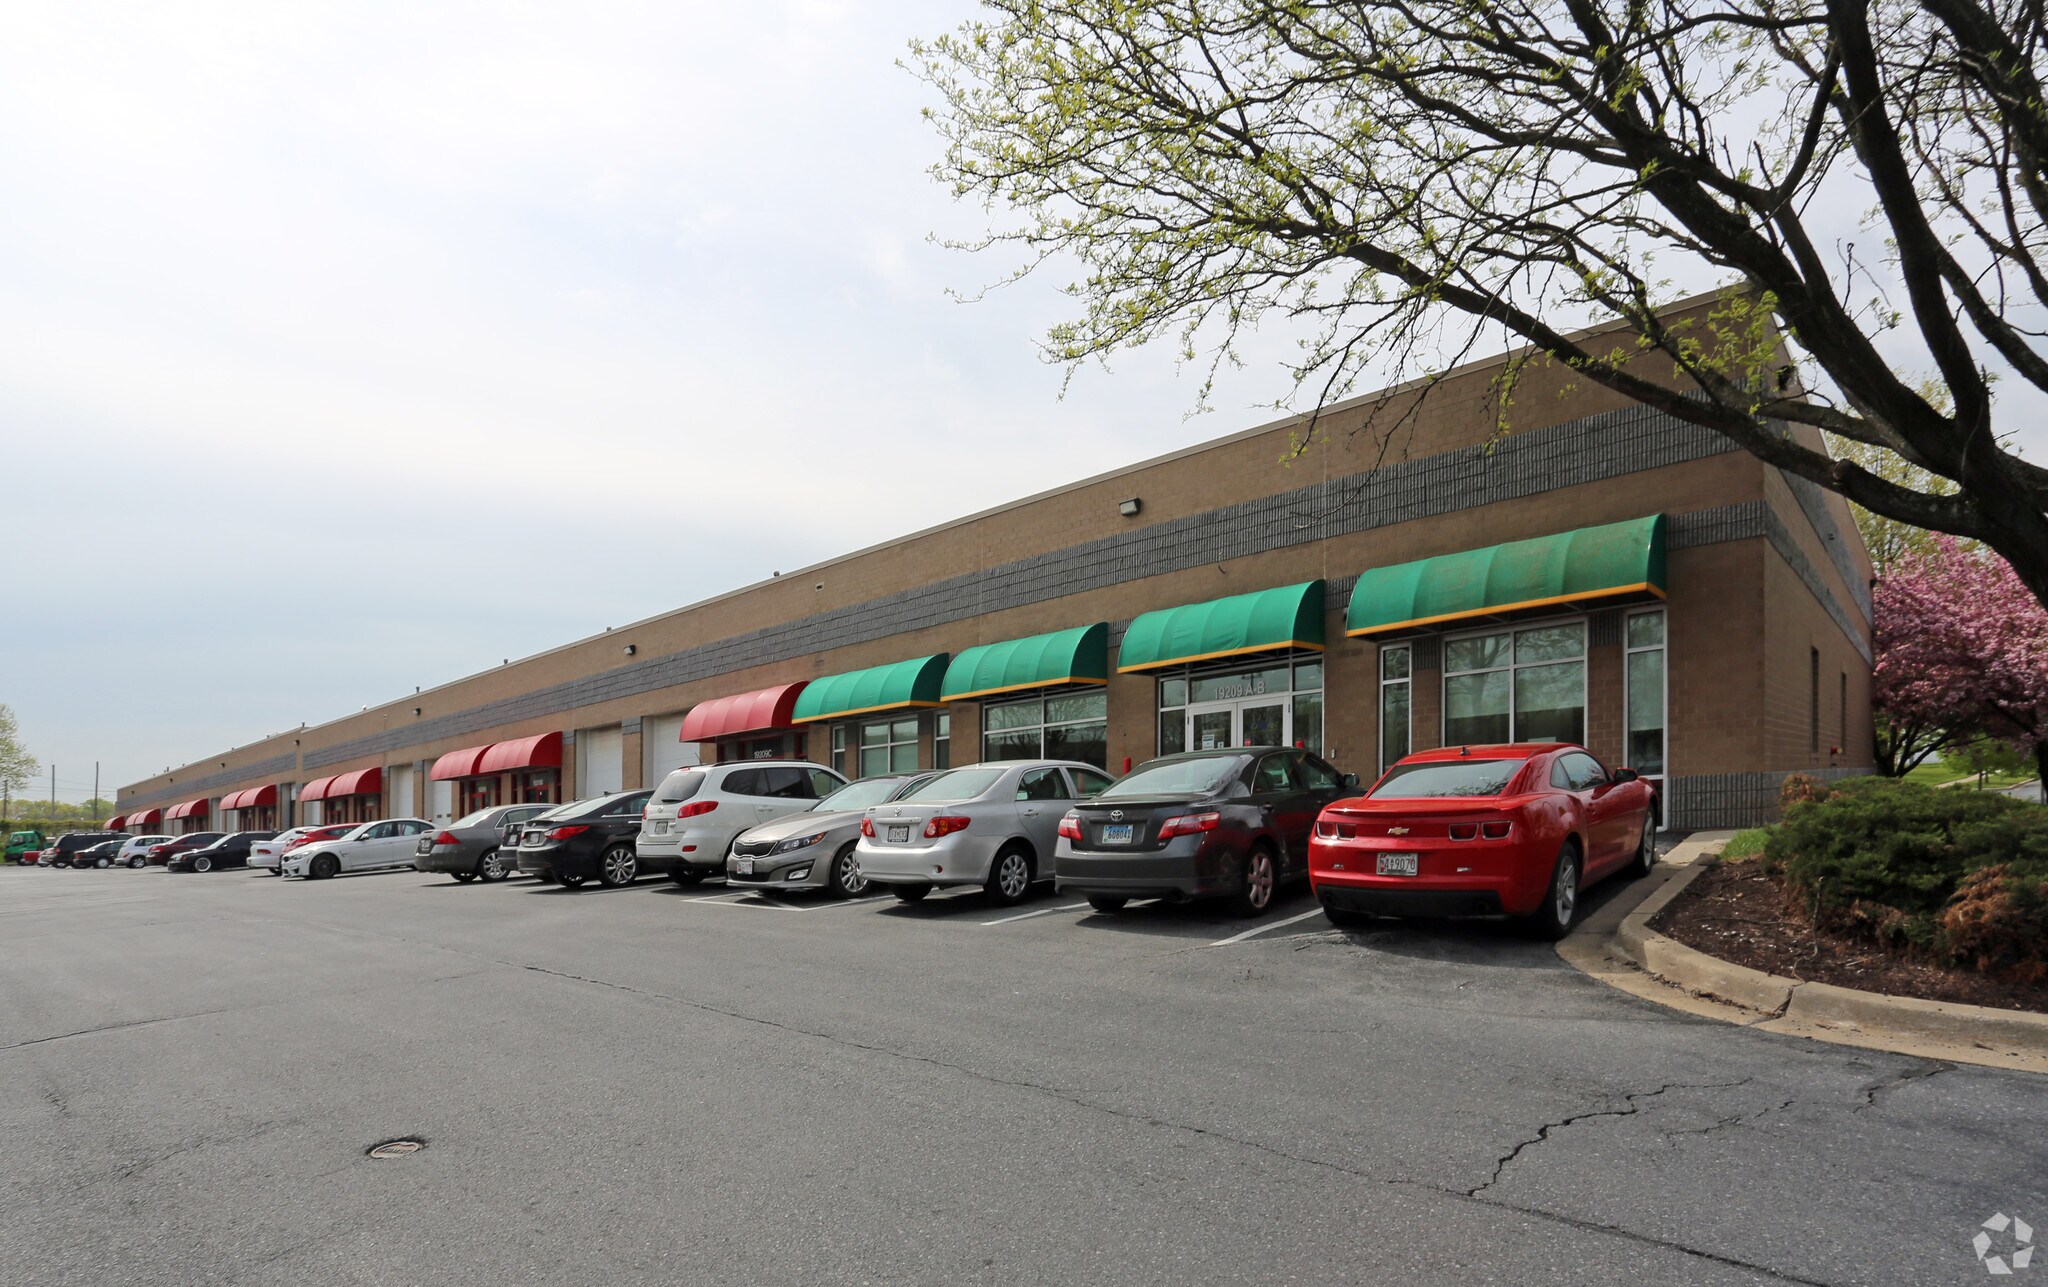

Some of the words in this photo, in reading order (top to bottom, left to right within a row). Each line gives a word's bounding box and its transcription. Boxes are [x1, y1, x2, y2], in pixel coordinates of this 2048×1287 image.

[1213, 684, 1243, 700] 19209
[1245, 681, 1266, 696] A-B
[754, 749, 773, 759] 19209C
